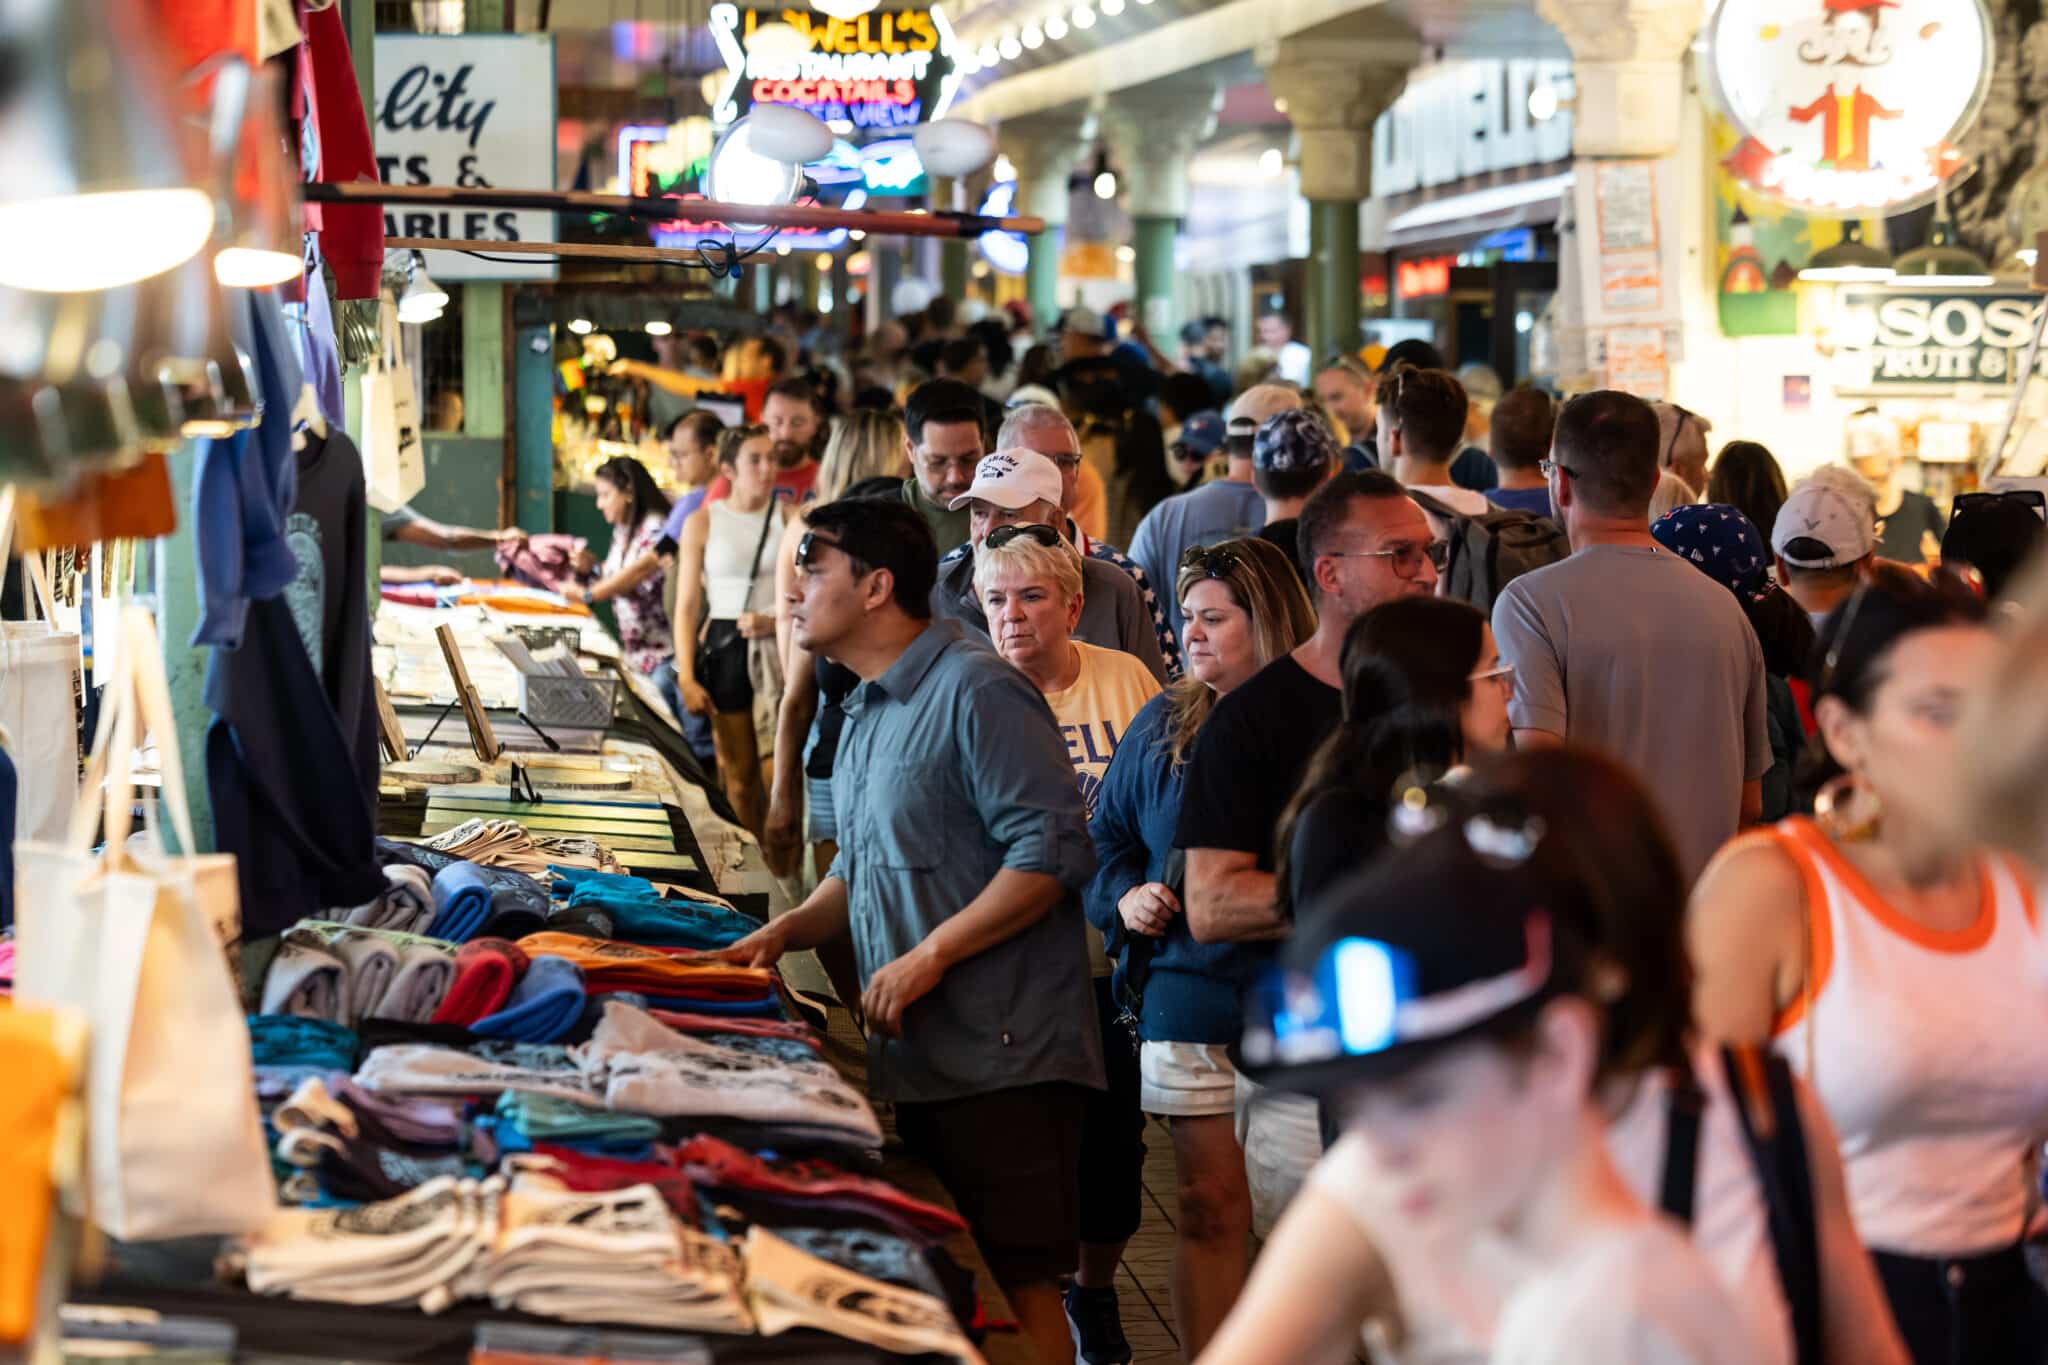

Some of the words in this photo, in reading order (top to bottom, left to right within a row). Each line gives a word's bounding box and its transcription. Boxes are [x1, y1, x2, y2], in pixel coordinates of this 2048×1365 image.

[745, 8, 938, 54] WELL'S
[752, 78, 916, 105] COCKTAILS
[456, 154, 494, 188] &
